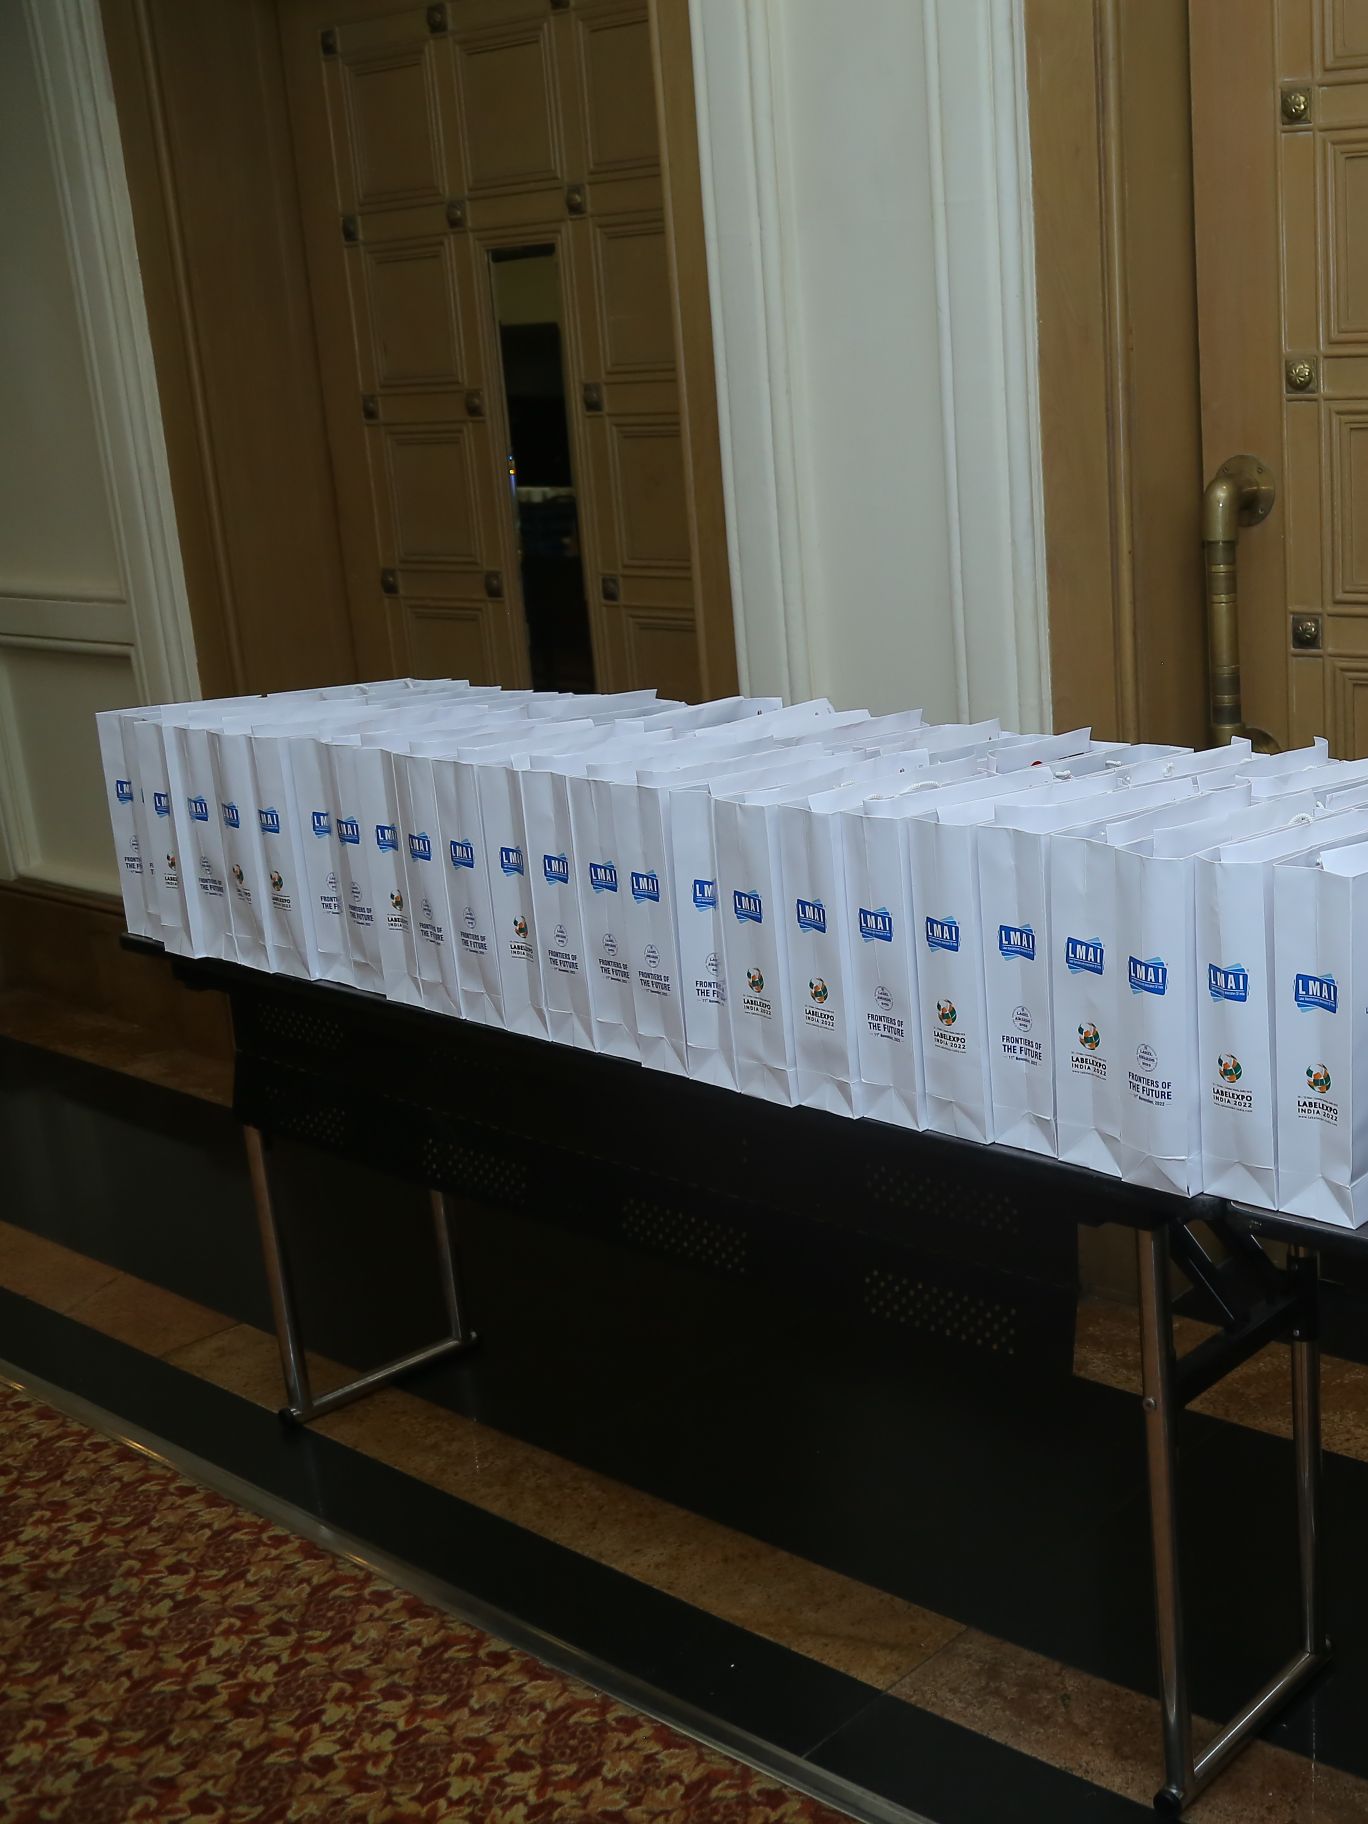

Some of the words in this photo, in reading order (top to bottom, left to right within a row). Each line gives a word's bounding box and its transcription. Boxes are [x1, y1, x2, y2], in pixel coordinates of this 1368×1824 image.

[410, 838, 428, 851] LMAI
[452, 845, 471, 858] LMAI
[546, 860, 566, 873] LMAI
[592, 868, 615, 881] LMAI
[633, 877, 657, 891] LMAI
[736, 895, 759, 912] LMAI
[799, 904, 823, 922] LMAI
[861, 913, 889, 930] LMAI
[928, 922, 955, 940] LMAI
[1002, 931, 1032, 948] LMAI
[1069, 943, 1100, 962] LMAI
[638, 971, 662, 980] FRONTIERS
[1131, 962, 1162, 983] LMAI
[1211, 969, 1244, 989] LMAI
[640, 979, 650, 987] THE
[652, 980, 670, 991] FUTURE
[1299, 980, 1334, 1000] LMAI
[696, 989, 710, 997] THE
[805, 1009, 834, 1021] LABELEXPO
[868, 1013, 896, 1026] FRONTIERS
[868, 1022, 880, 1031] THE
[883, 1024, 904, 1037] FUTURE
[934, 1031, 965, 1043] LABELEXPO
[1002, 1035, 1034, 1048] FRONTIERS
[1035, 1042, 1042, 1050] OF
[1002, 1044, 1016, 1053] THE
[1020, 1046, 1042, 1061] FUTURE
[1072, 1056, 1106, 1070] LABELEXPO
[1094, 1067, 1106, 1076] 2022
[1129, 1071, 1159, 1089] FRONTIERS
[1162, 1081, 1171, 1089] OF
[1129, 1081, 1140, 1093] THE
[1142, 1086, 1172, 1100] FUTURE
[1213, 1088, 1252, 1101] LABELEXPO
[1213, 1095, 1230, 1104] INDIA
[1298, 1100, 1338, 1115] LABELEXPO
[1323, 1112, 1337, 1121] 2022
